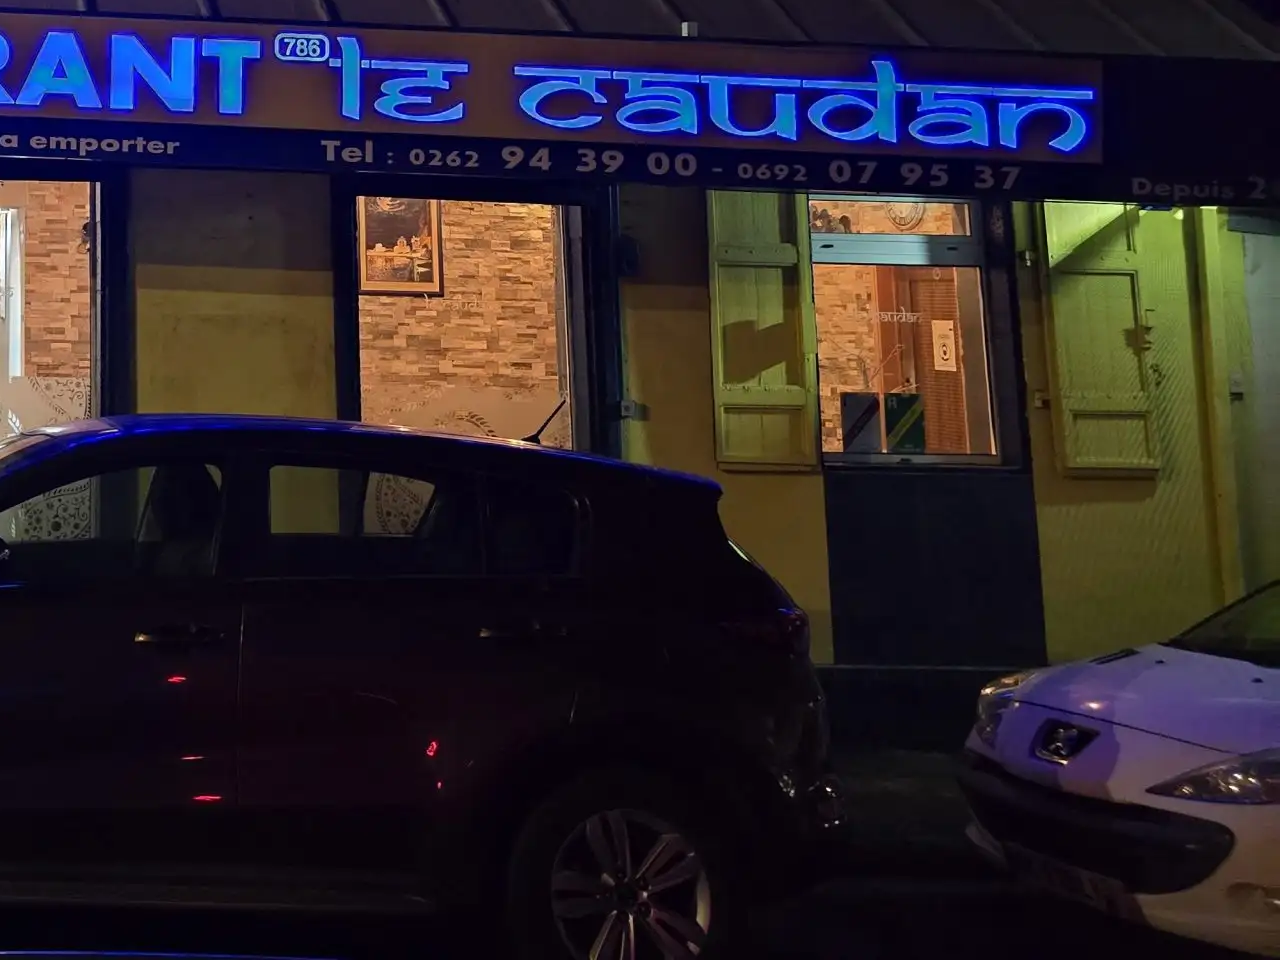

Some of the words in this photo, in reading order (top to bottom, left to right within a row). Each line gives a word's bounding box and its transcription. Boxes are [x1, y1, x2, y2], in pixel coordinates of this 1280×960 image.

[284, 38, 321, 58] 786
[515, 59, 1096, 155] caudan
[29, 135, 181, 157] emporter
[320, 139, 374, 164] Tel
[408, 147, 481, 168] 0262
[500, 144, 553, 172] 94
[575, 147, 625, 174] 39
[645, 151, 698, 178] 00
[736, 161, 809, 183] 0692
[828, 159, 879, 185] 07
[900, 161, 950, 188] 95
[973, 164, 1023, 191] 37
[1131, 175, 1236, 203] Depuis
